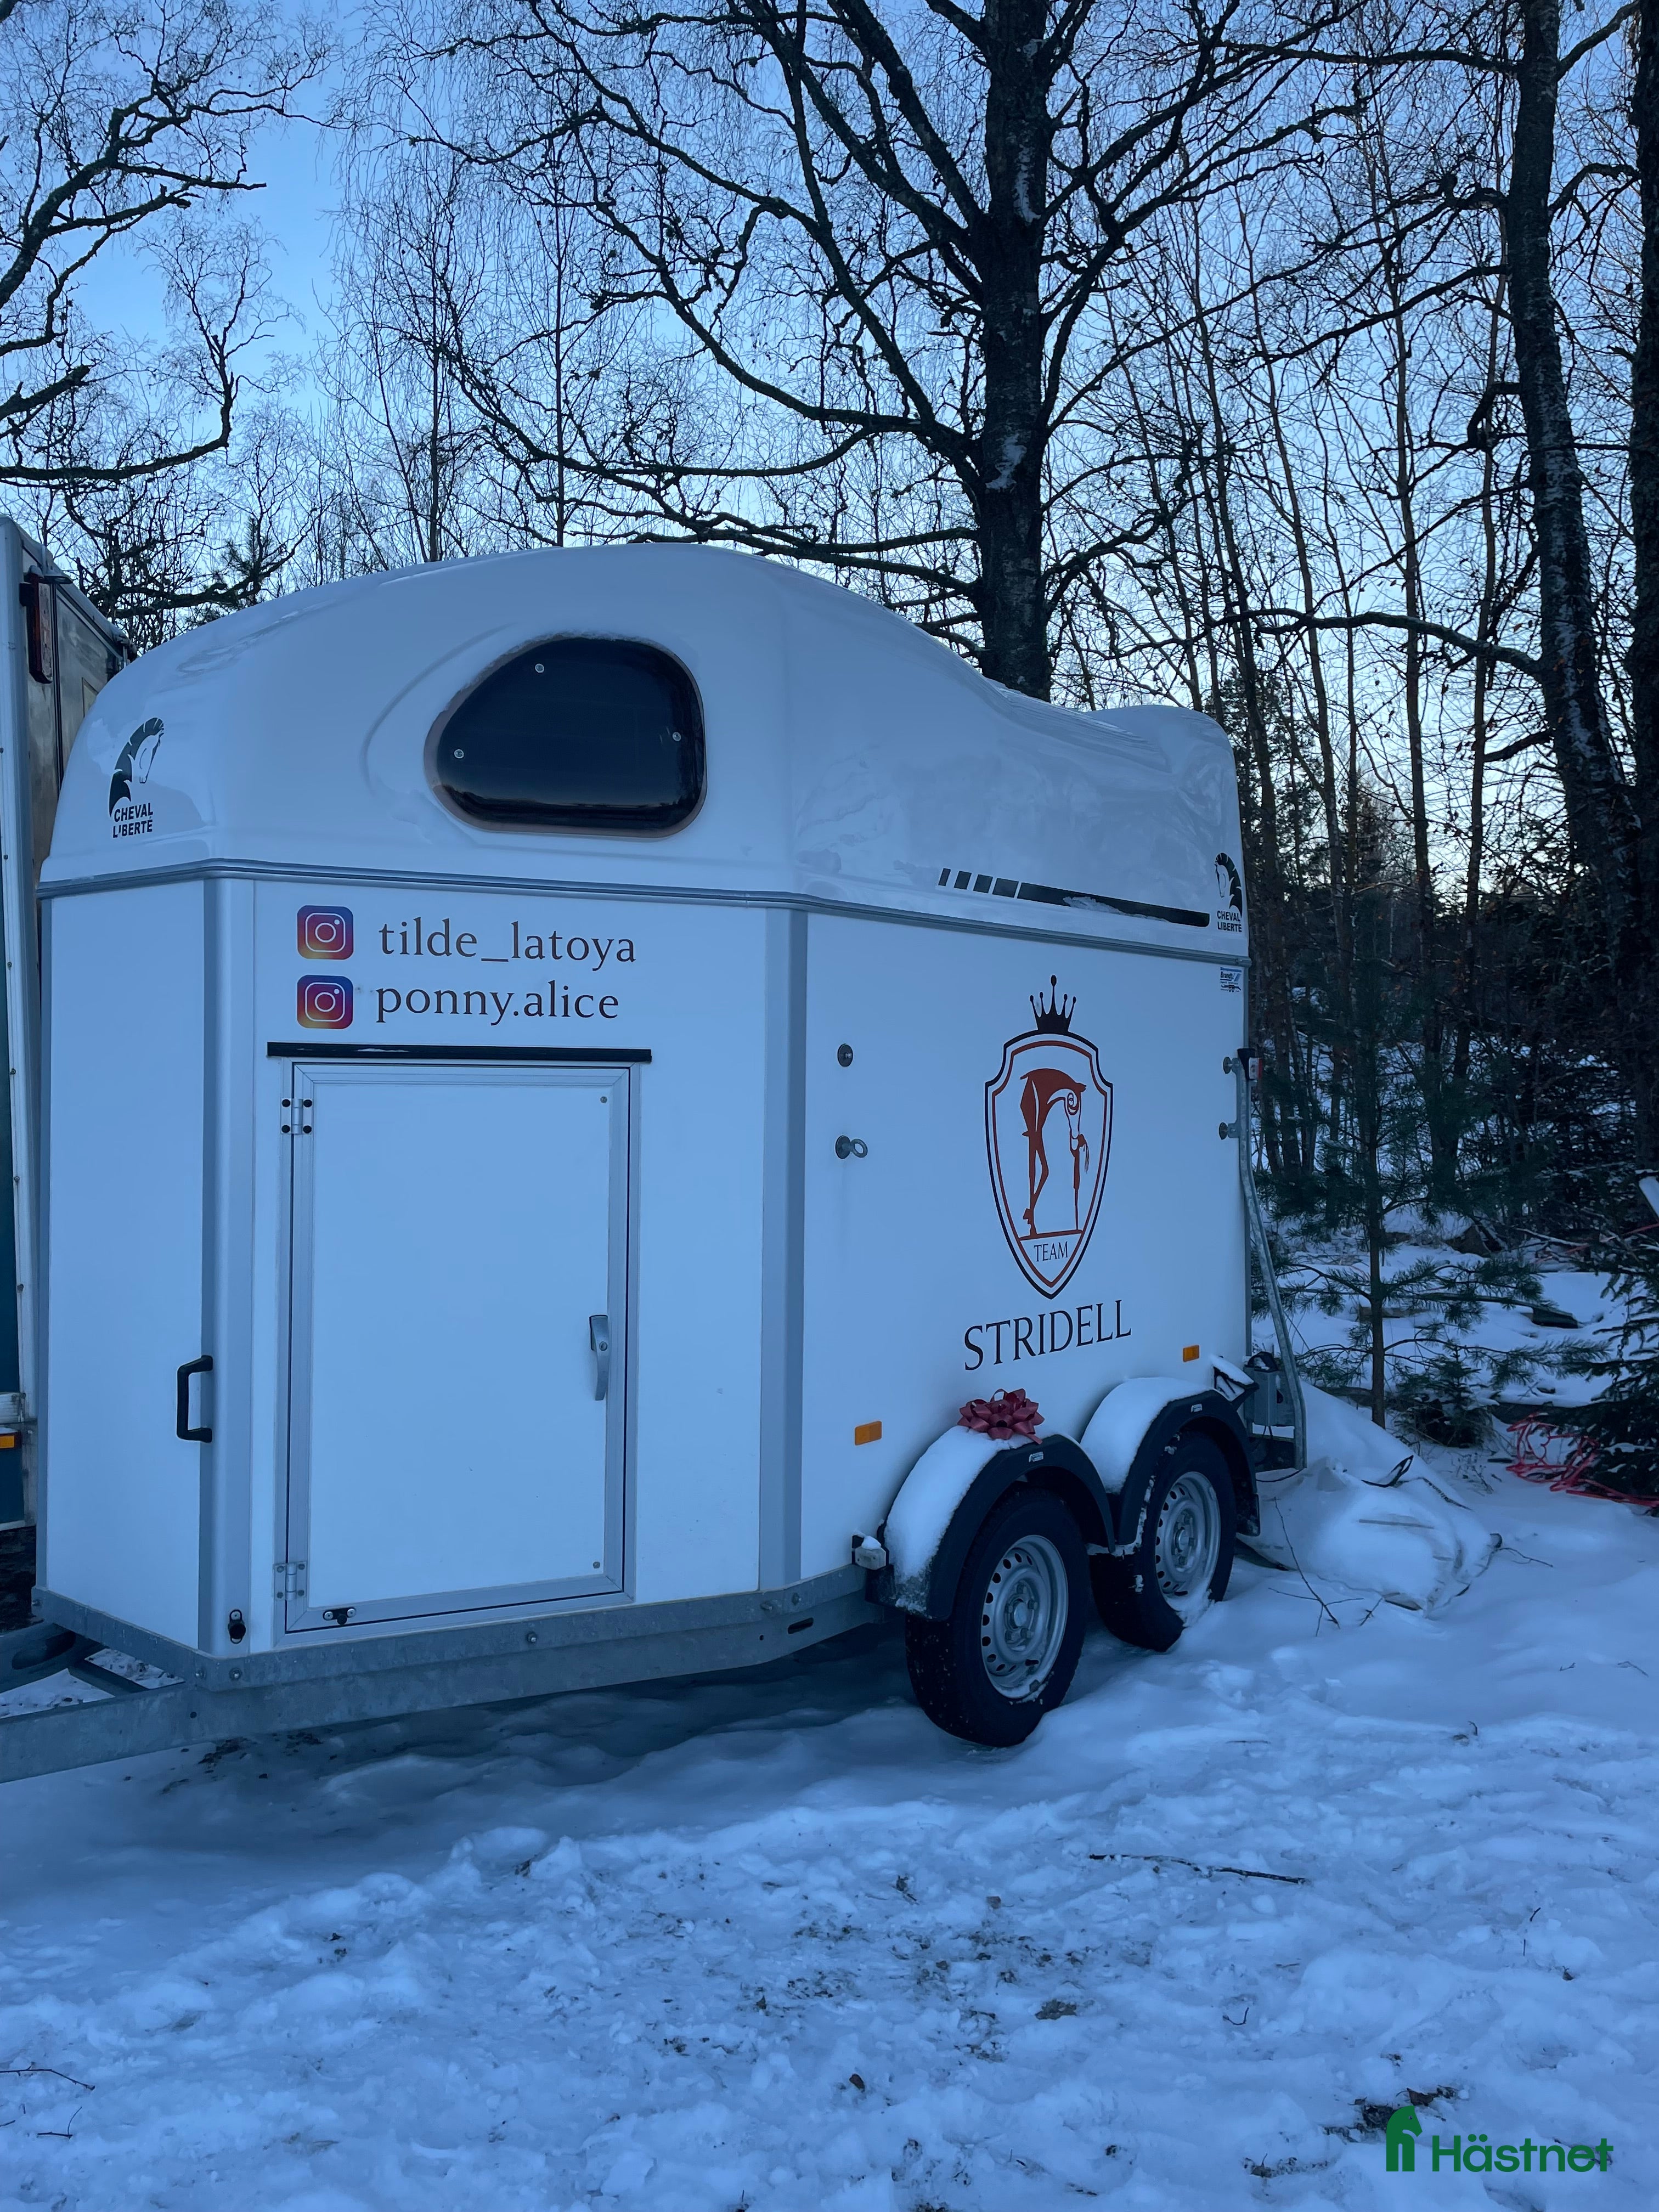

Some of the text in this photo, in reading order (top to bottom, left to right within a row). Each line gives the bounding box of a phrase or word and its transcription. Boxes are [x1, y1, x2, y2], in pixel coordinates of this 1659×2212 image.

[114, 803, 153, 822] CHEVAL
[112, 816, 153, 838] LIBERTÉ
[1217, 910, 1240, 922] CHEVAL
[379, 917, 636, 972] tilde_latoya
[375, 980, 619, 1026] ponny.alice
[1034, 1241, 1068, 1262] TEAM
[964, 1299, 1132, 1370] STRIDELL
